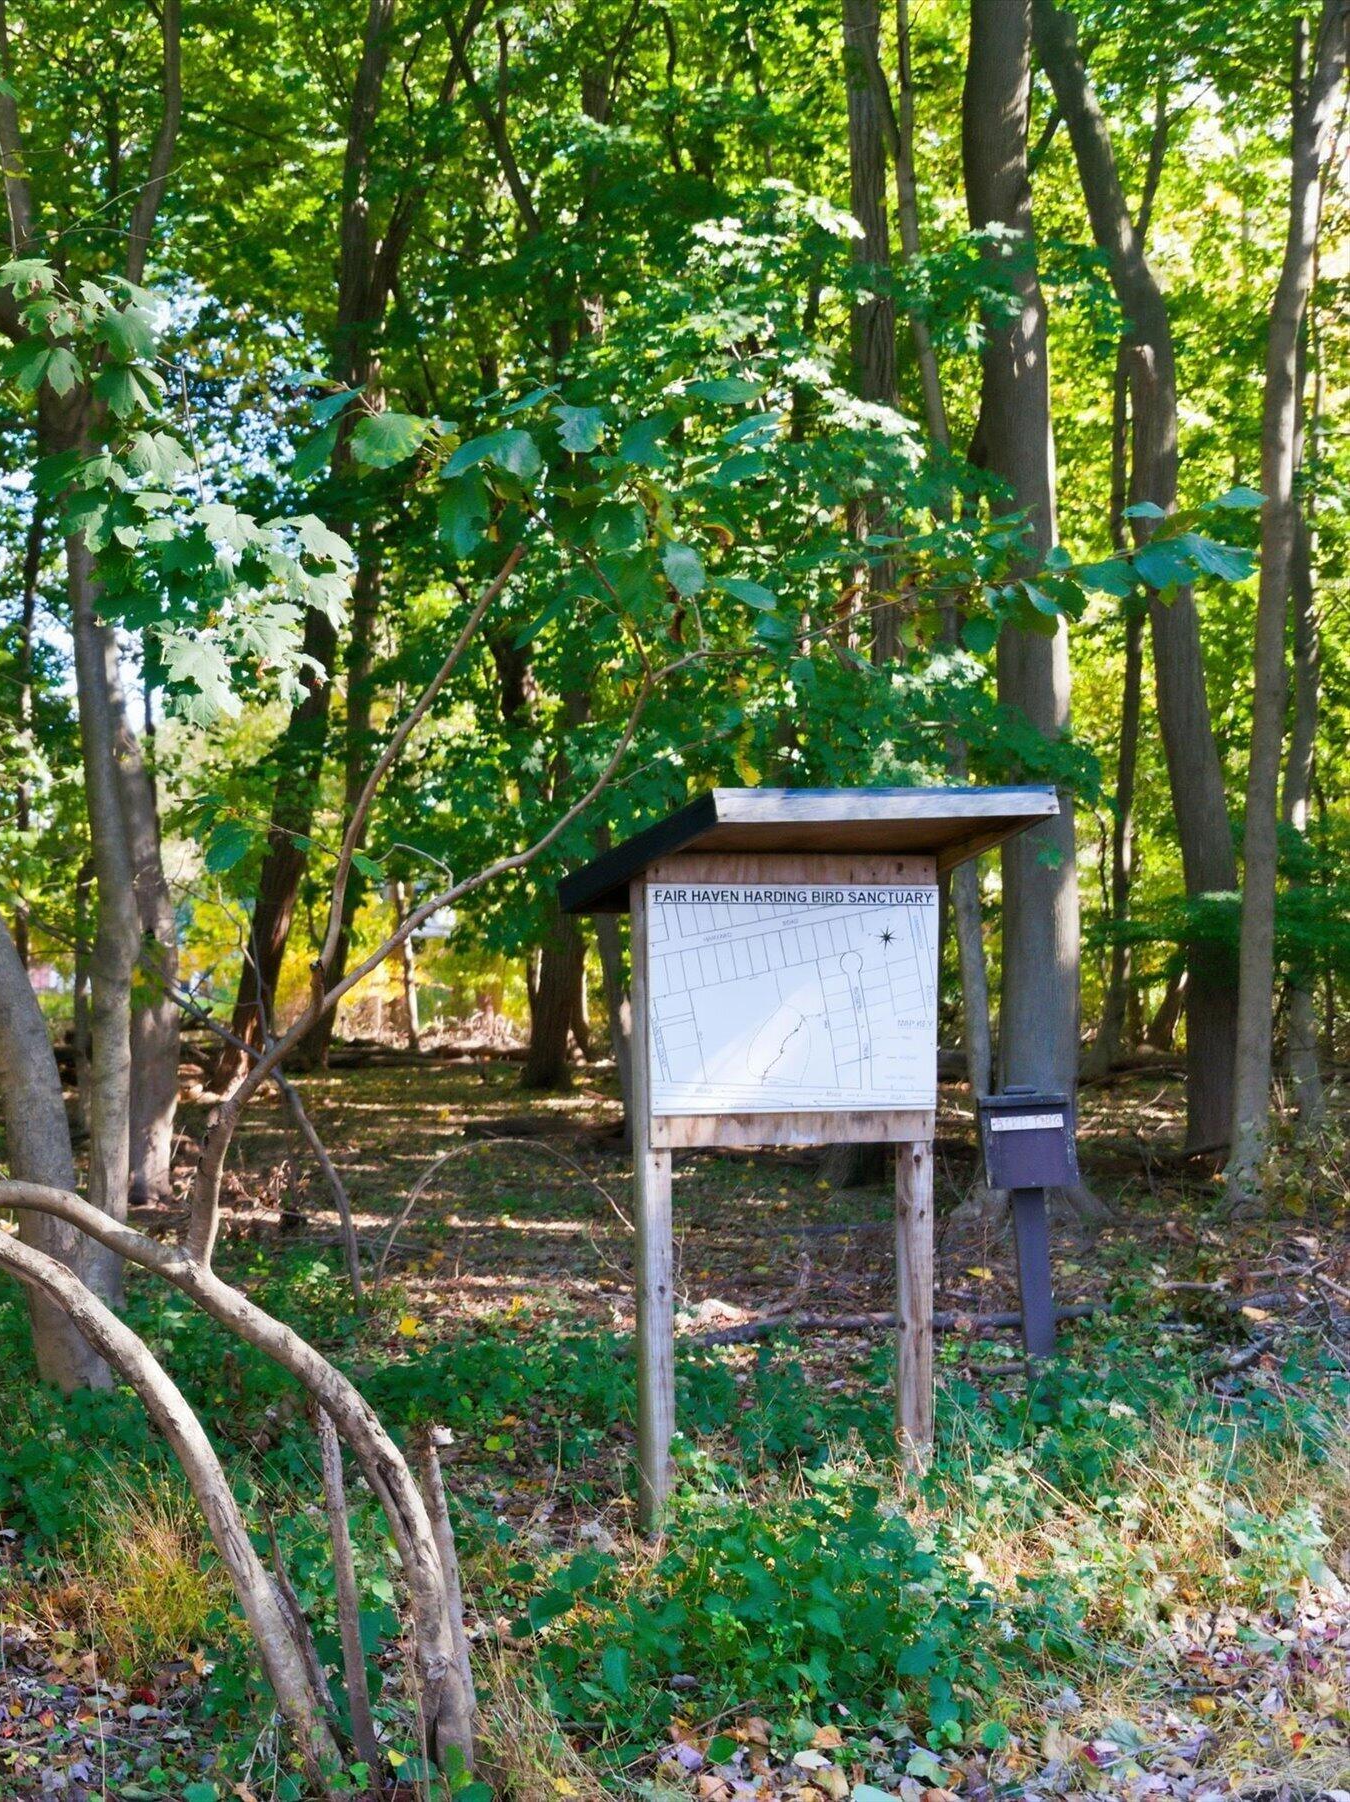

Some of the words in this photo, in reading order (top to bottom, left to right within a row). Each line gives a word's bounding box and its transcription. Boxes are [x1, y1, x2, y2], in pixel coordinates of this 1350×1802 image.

[654, 889, 687, 902] FAIR
[692, 890, 739, 903] HAVEN
[744, 890, 807, 903] HARDING
[812, 890, 844, 903] BIRD
[849, 891, 932, 904] SANCTUARY
